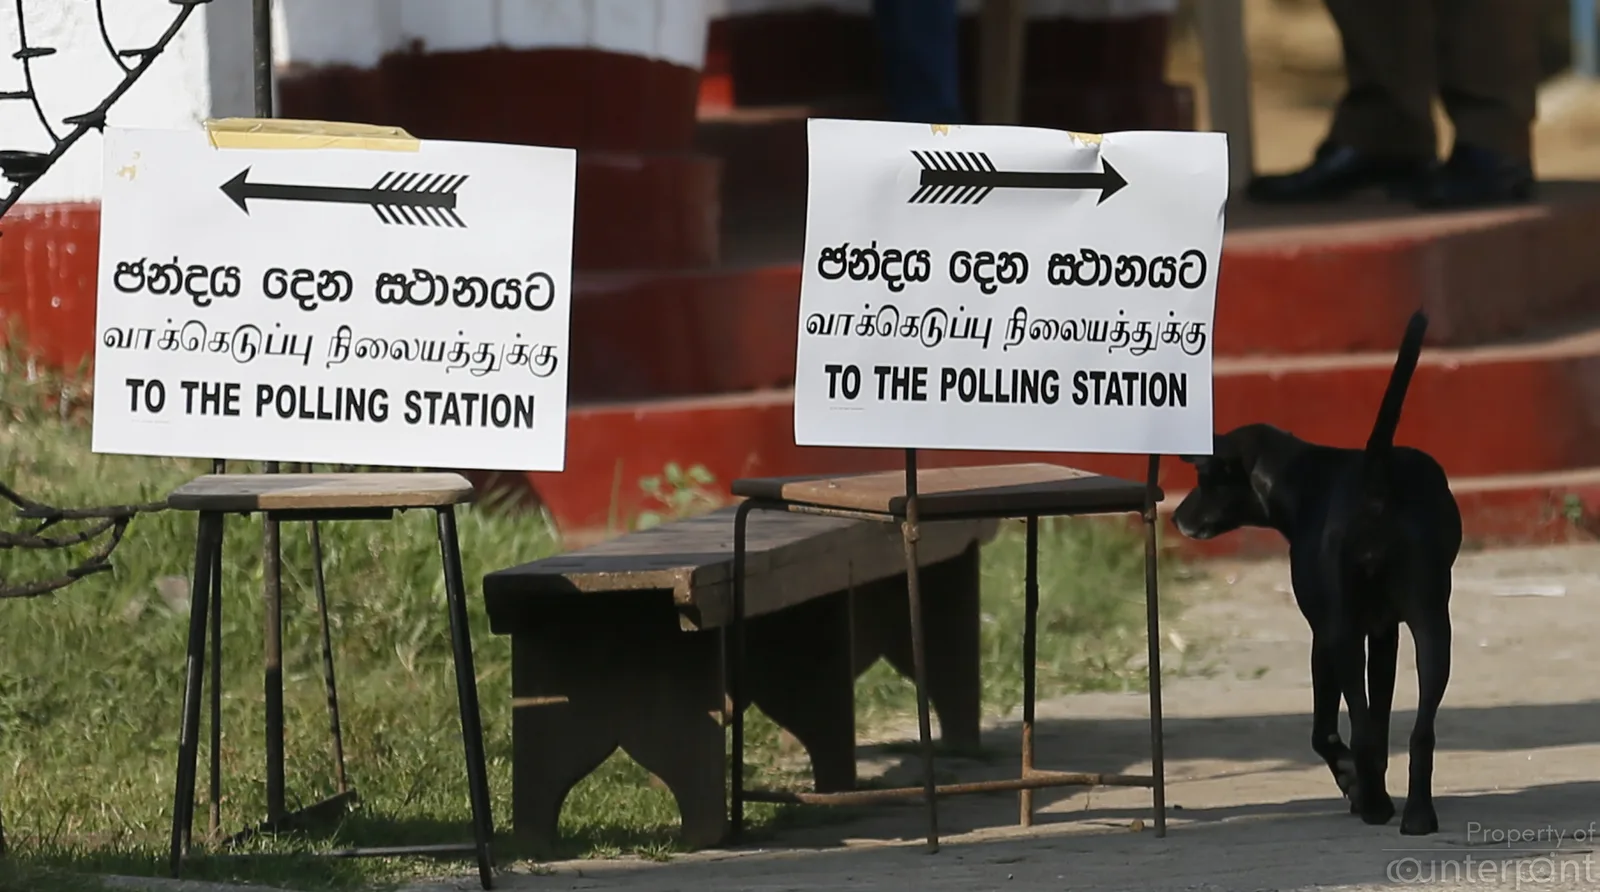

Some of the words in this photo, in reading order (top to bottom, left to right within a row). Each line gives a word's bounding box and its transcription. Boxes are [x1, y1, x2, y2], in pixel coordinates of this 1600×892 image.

[114, 256, 240, 307] ඡන්දය
[263, 268, 353, 311] දෙන
[818, 241, 930, 292] ඡන්දය
[949, 251, 1028, 294] දෙන
[104, 319, 312, 365] வாக்கெடுப்பு
[327, 325, 557, 377] நிலையத்துக்கு
[807, 304, 992, 349] வாக்கெடுப்பு
[1003, 307, 1206, 356] நிலையத்துக்கு
[126, 379, 165, 413] TO
[181, 381, 240, 416] THE
[256, 384, 388, 422] POLLING
[404, 390, 534, 428] STATION
[825, 365, 861, 400] TO
[874, 366, 927, 401] THE
[941, 368, 1059, 404] POLLING
[1072, 370, 1186, 407] STATION
